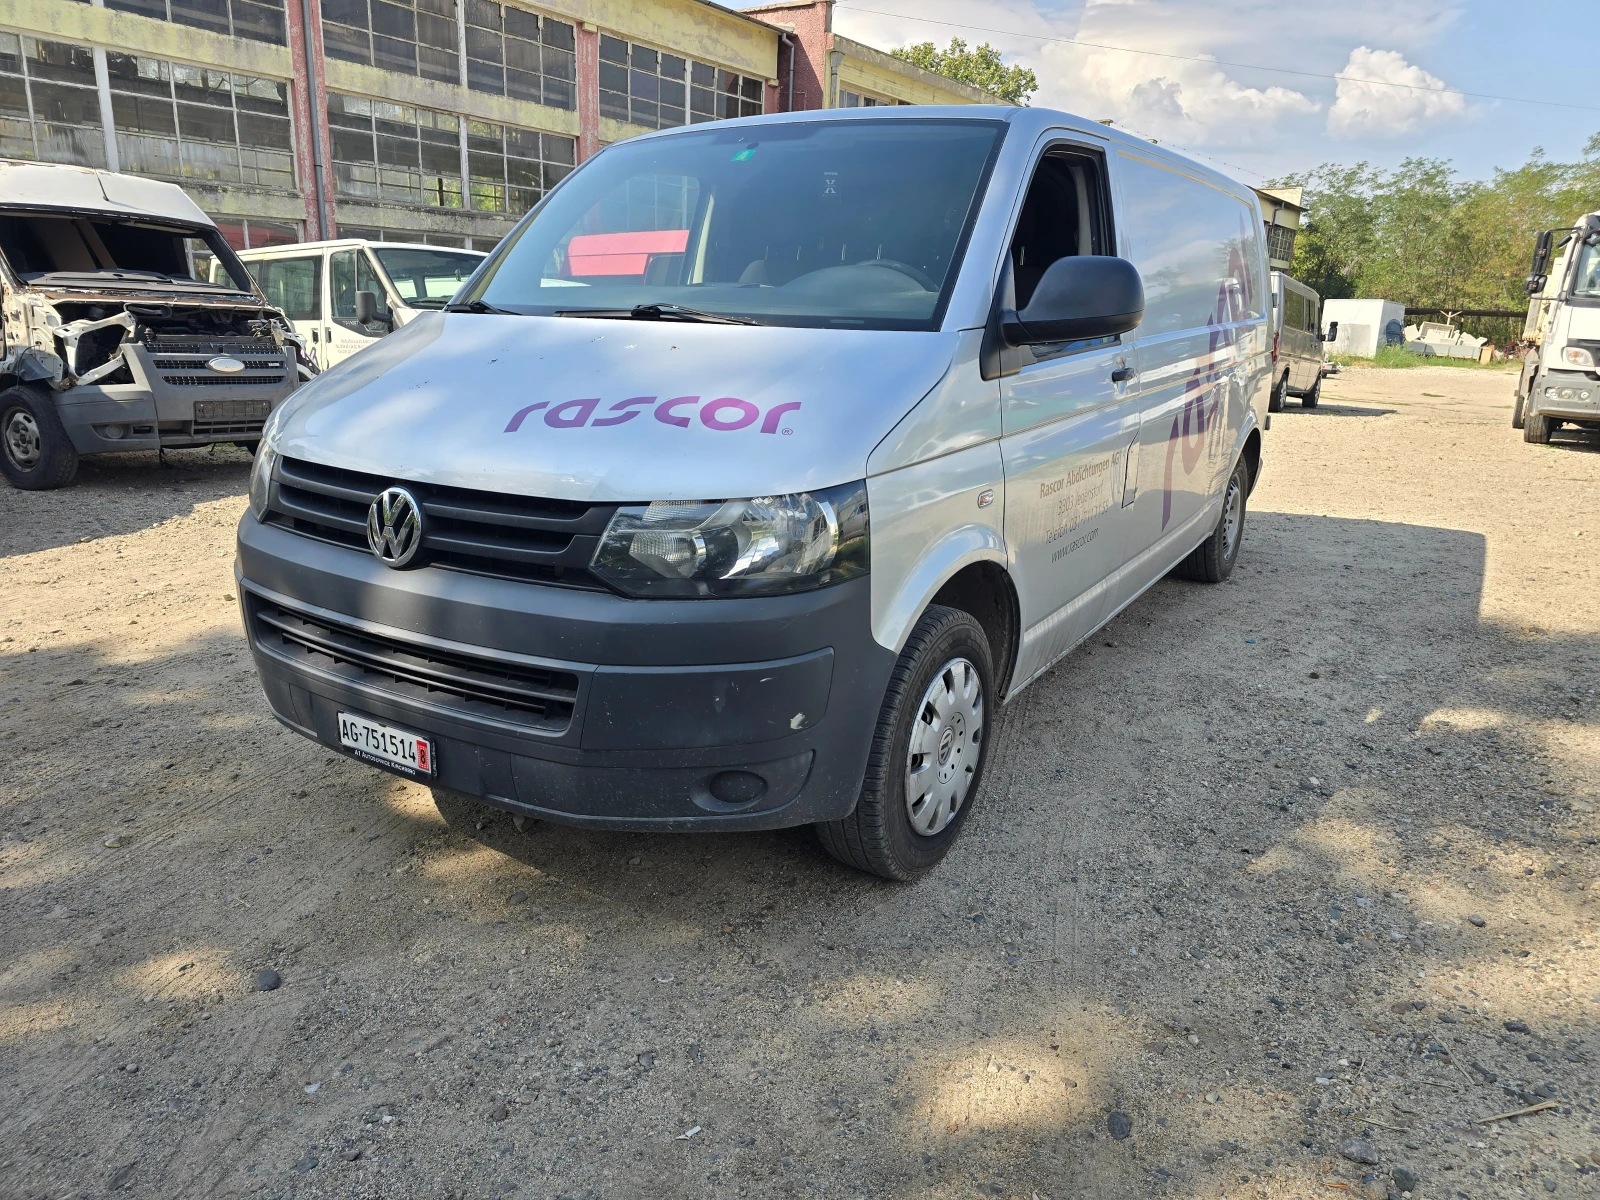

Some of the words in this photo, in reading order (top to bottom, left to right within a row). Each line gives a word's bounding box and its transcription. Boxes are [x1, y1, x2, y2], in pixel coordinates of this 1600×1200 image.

[503, 396, 802, 435] rascor
[1040, 478, 1065, 499] Rascor
[1066, 458, 1110, 488] Abdichtungen
[1111, 451, 1120, 468] AG
